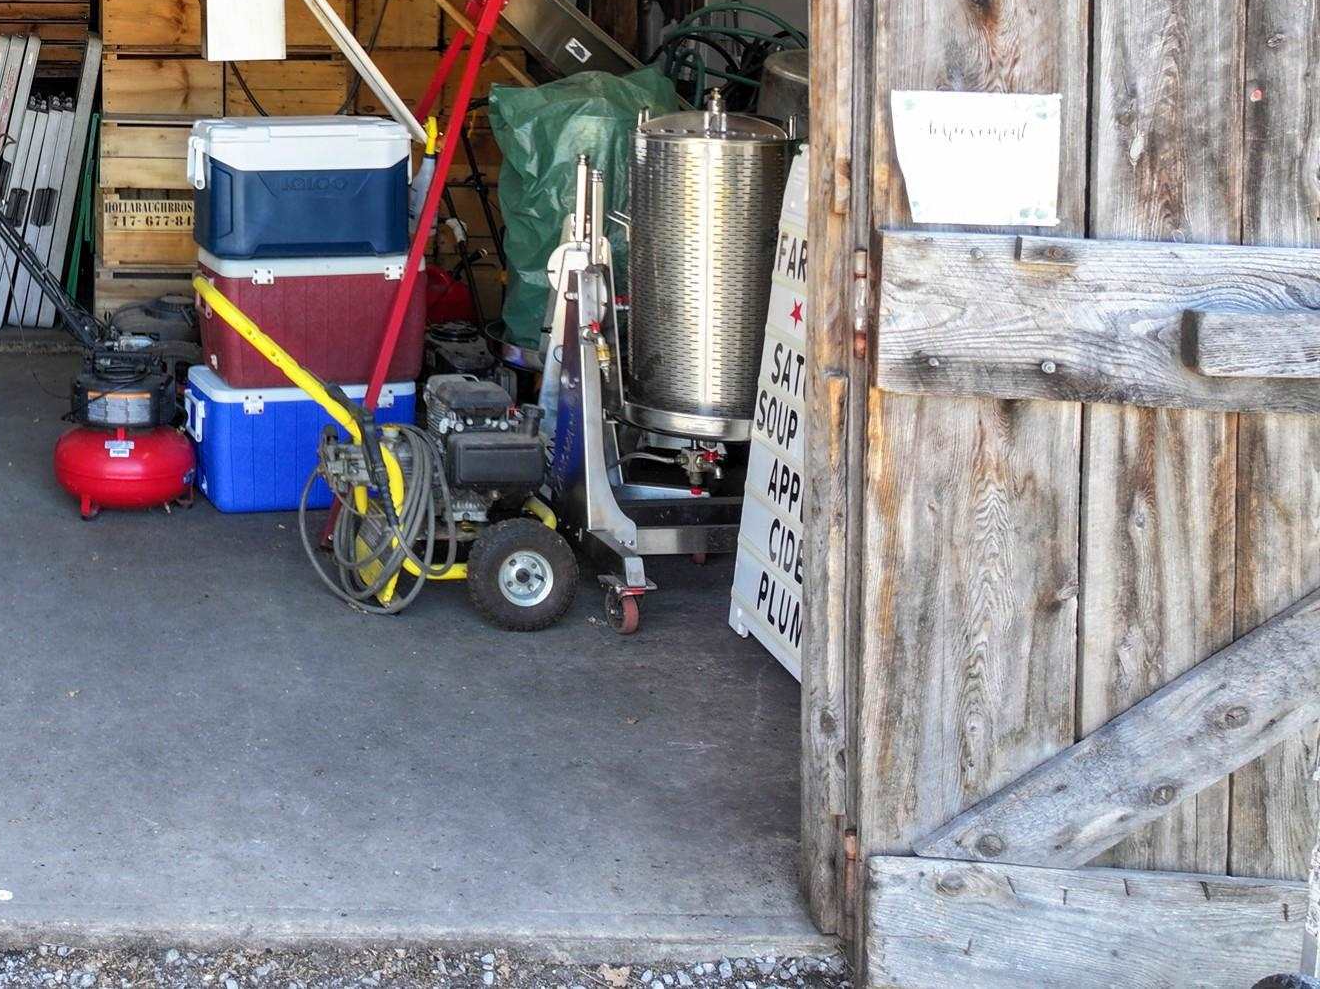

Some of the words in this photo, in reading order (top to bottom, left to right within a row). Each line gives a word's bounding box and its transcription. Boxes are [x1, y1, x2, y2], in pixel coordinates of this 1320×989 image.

[771, 342, 806, 402] SAT
[757, 389, 798, 451] SOUP
[768, 458, 804, 523] APP
